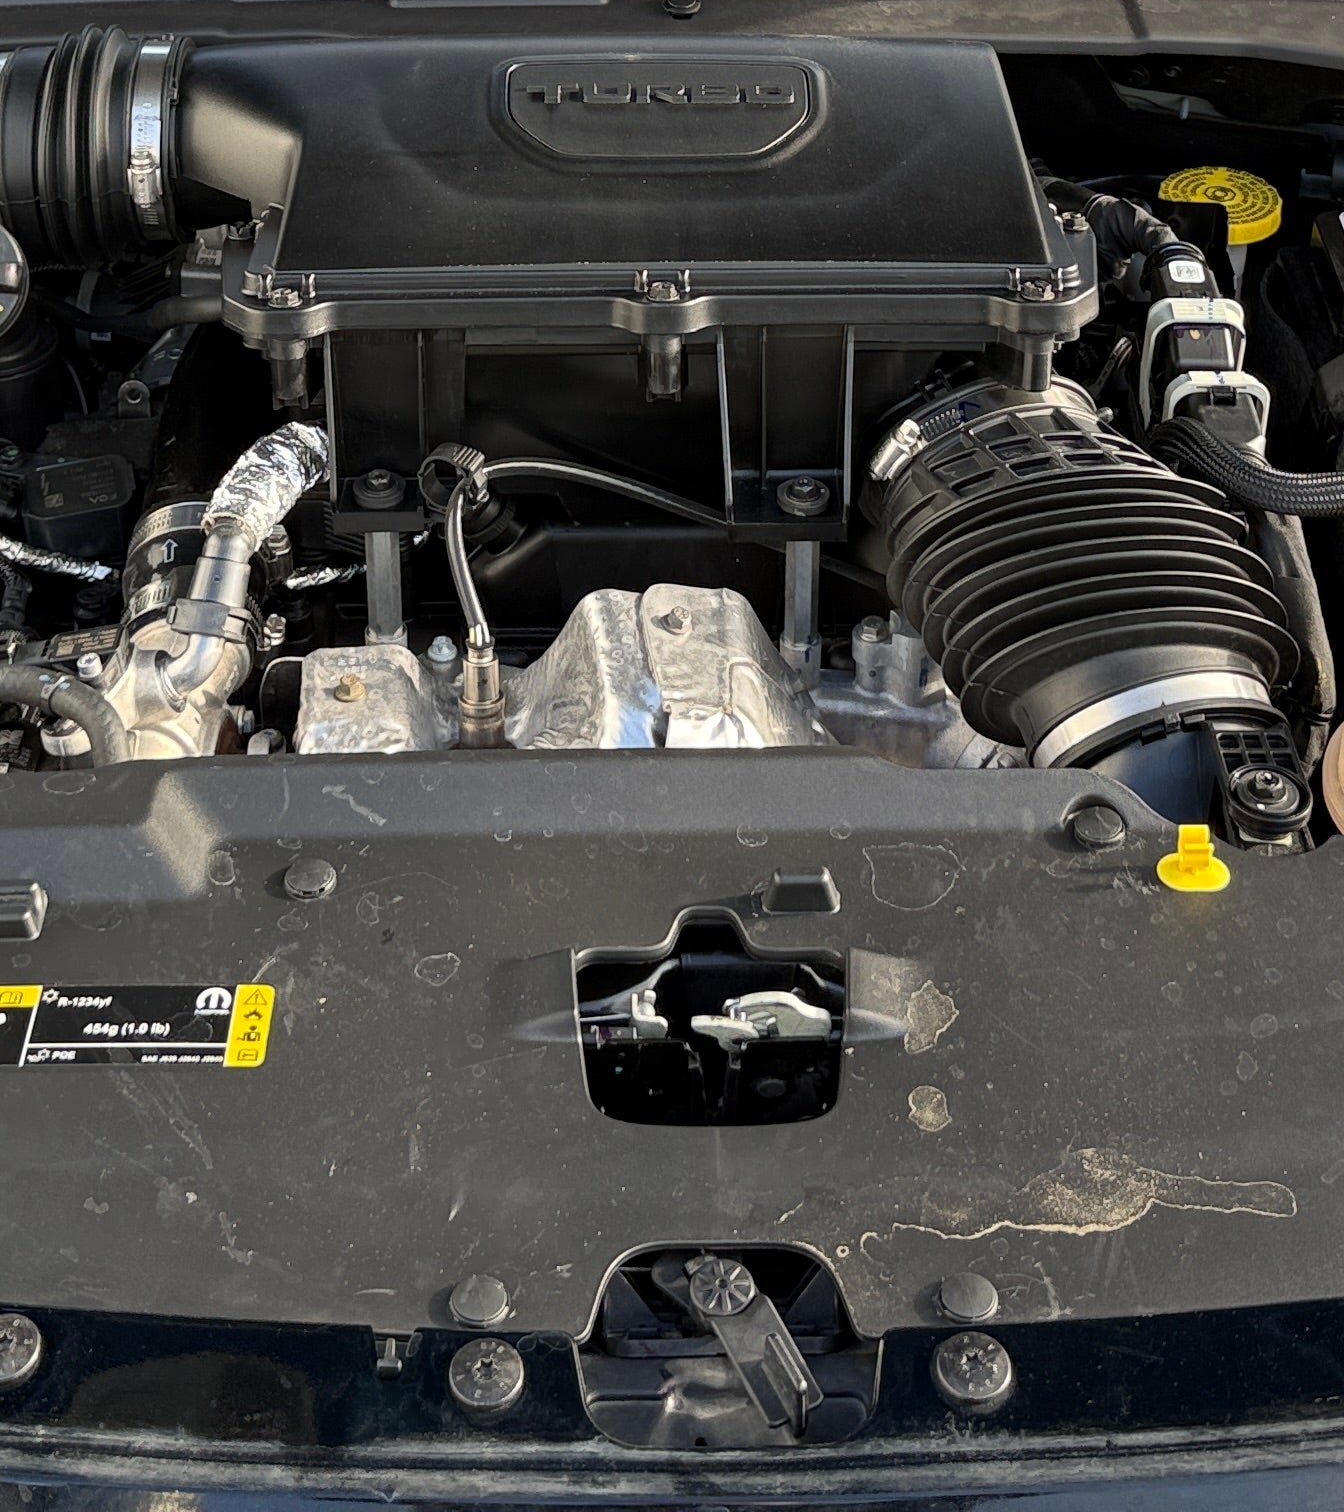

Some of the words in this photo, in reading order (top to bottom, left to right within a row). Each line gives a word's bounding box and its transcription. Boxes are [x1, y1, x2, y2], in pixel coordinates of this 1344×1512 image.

[524, 82, 795, 104] TURBO
[57, 996, 113, 1010] R-1234yf
[82, 1022, 119, 1037] 454g
[121, 1022, 149, 1037] (1.0
[150, 1022, 170, 1037] lb)
[52, 1050, 76, 1061] POE
